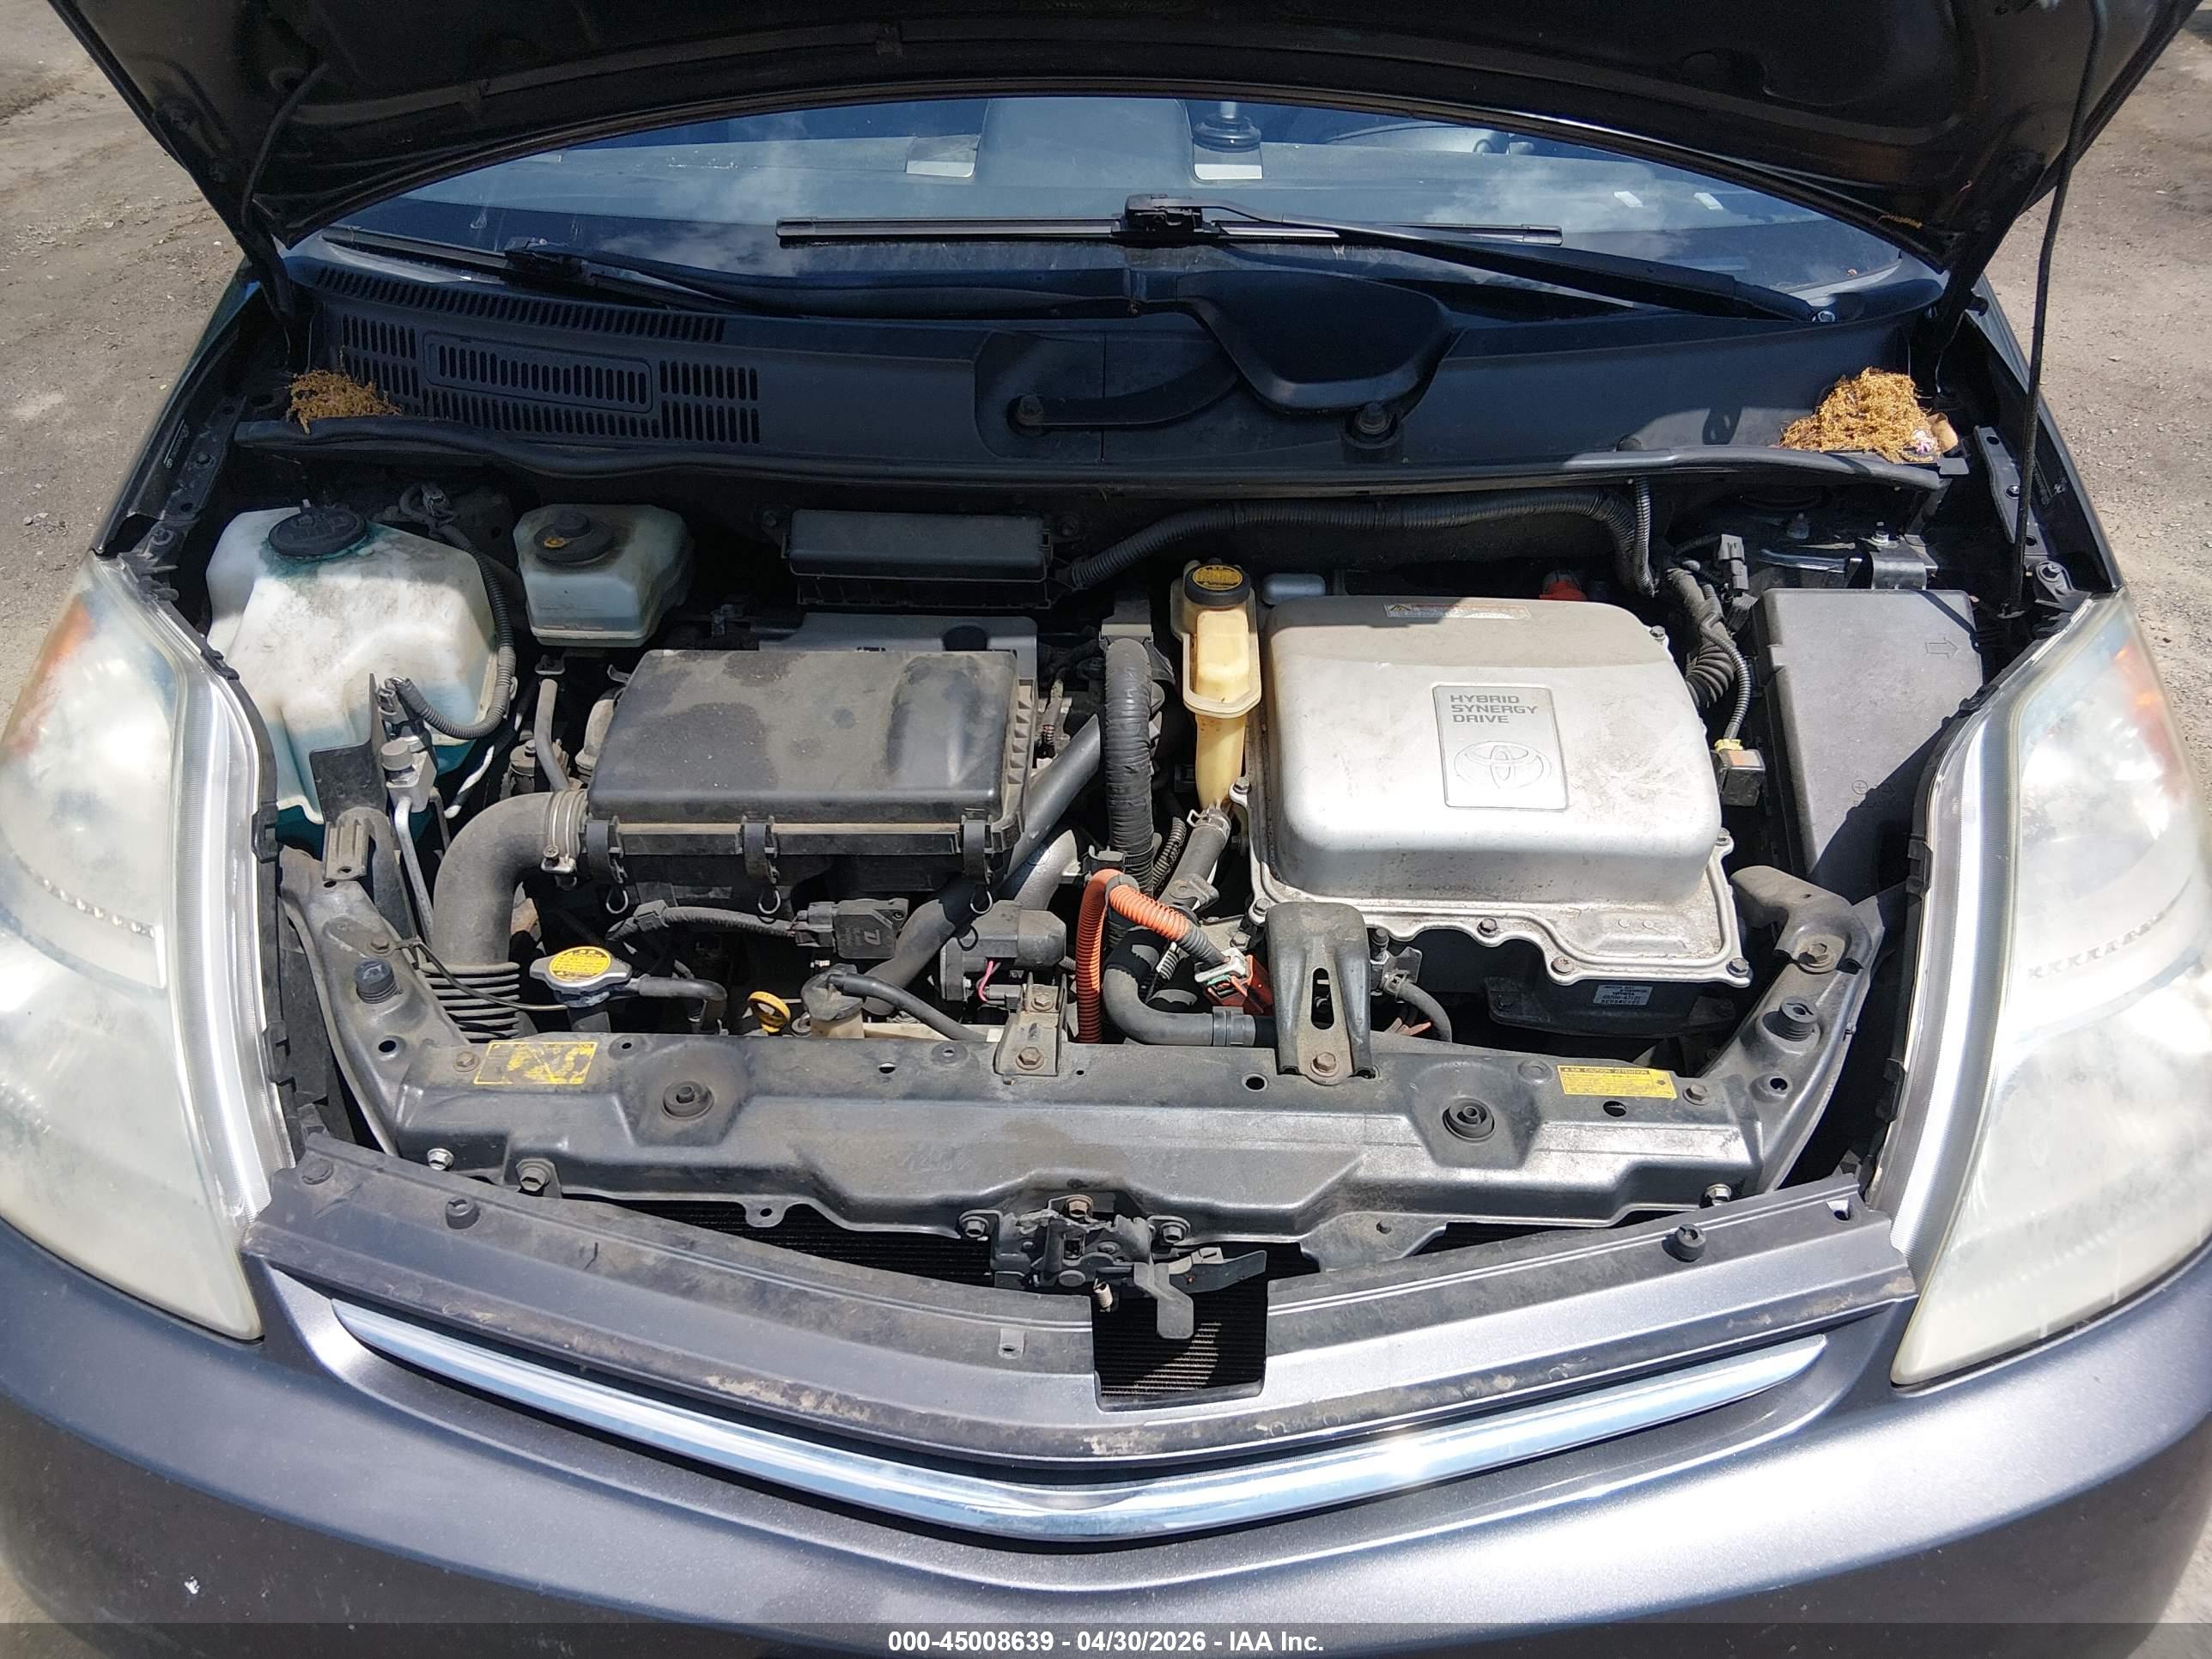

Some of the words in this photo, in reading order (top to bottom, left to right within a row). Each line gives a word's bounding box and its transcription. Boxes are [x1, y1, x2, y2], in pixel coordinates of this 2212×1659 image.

[1449, 695, 1520, 703] HYBRID
[1451, 704, 1538, 714] SYNERGY
[1452, 714, 1509, 723] DRIVE
